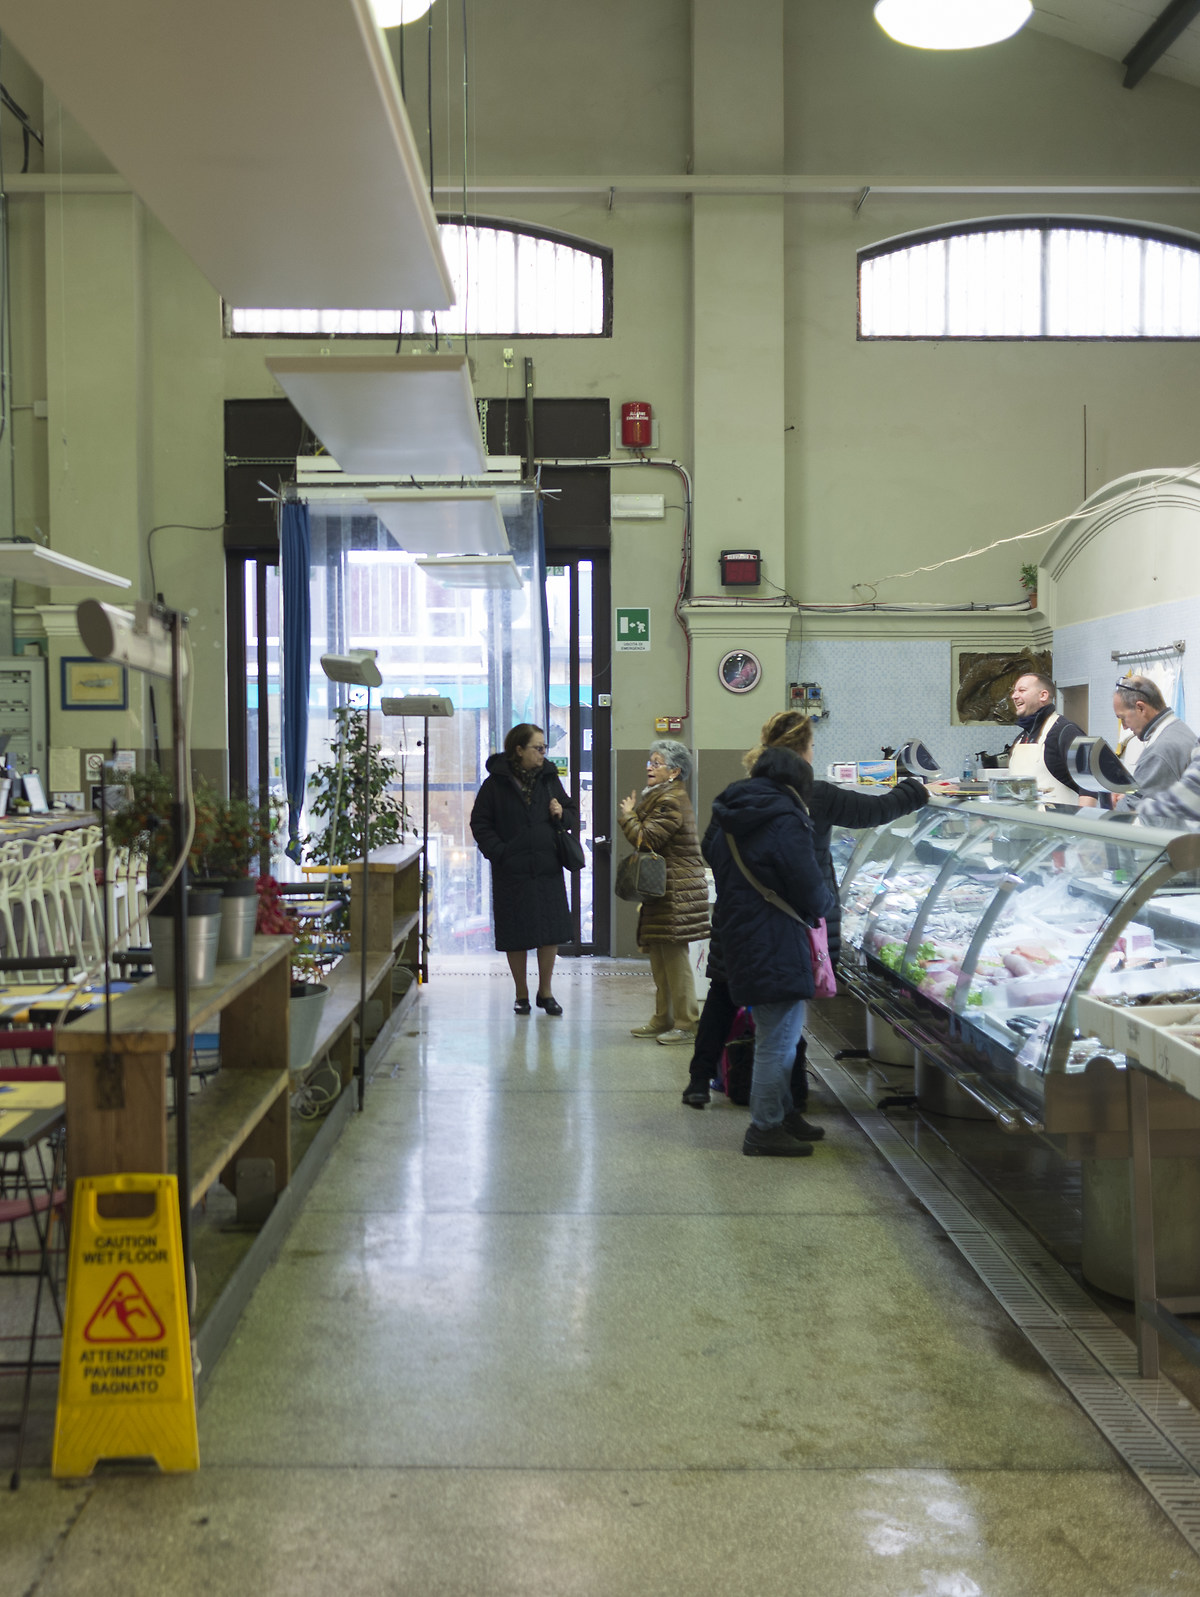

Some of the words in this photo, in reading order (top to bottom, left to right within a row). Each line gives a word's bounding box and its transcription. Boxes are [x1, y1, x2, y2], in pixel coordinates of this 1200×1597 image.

[95, 1235, 157, 1249] CAUTION
[83, 1251, 113, 1265] WET
[118, 1249, 168, 1264] FLOOR
[80, 1348, 168, 1363] ATTENZIONE
[84, 1363, 165, 1379] PAVIMENTO
[91, 1380, 159, 1395] BAGNATO
